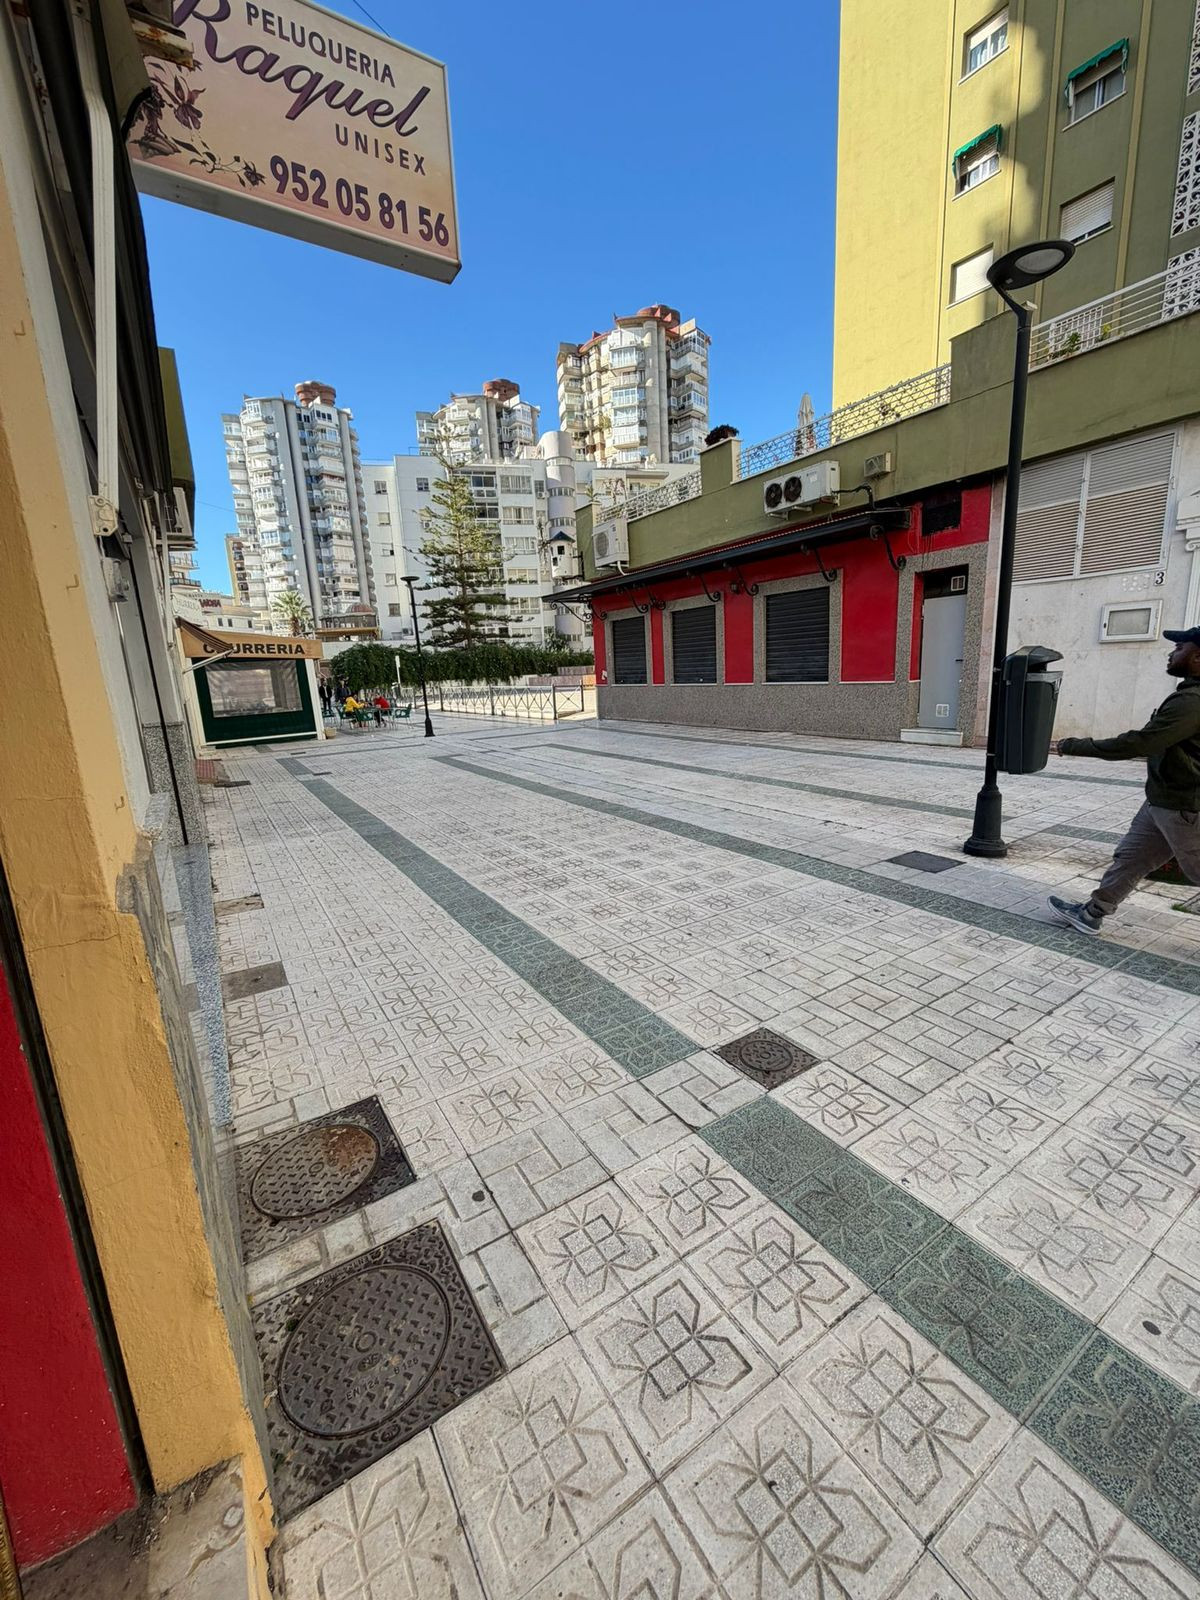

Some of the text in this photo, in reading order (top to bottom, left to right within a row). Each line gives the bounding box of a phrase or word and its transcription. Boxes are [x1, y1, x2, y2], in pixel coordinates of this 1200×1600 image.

[173, 0, 431, 138] Raquel
[246, 2, 396, 88] PELUQUERIA
[335, 123, 426, 176] UNISEX
[270, 155, 449, 247] 952 05 81 56
[1155, 571, 1165, 585] 3
[203, 643, 306, 655] CURRERIA
